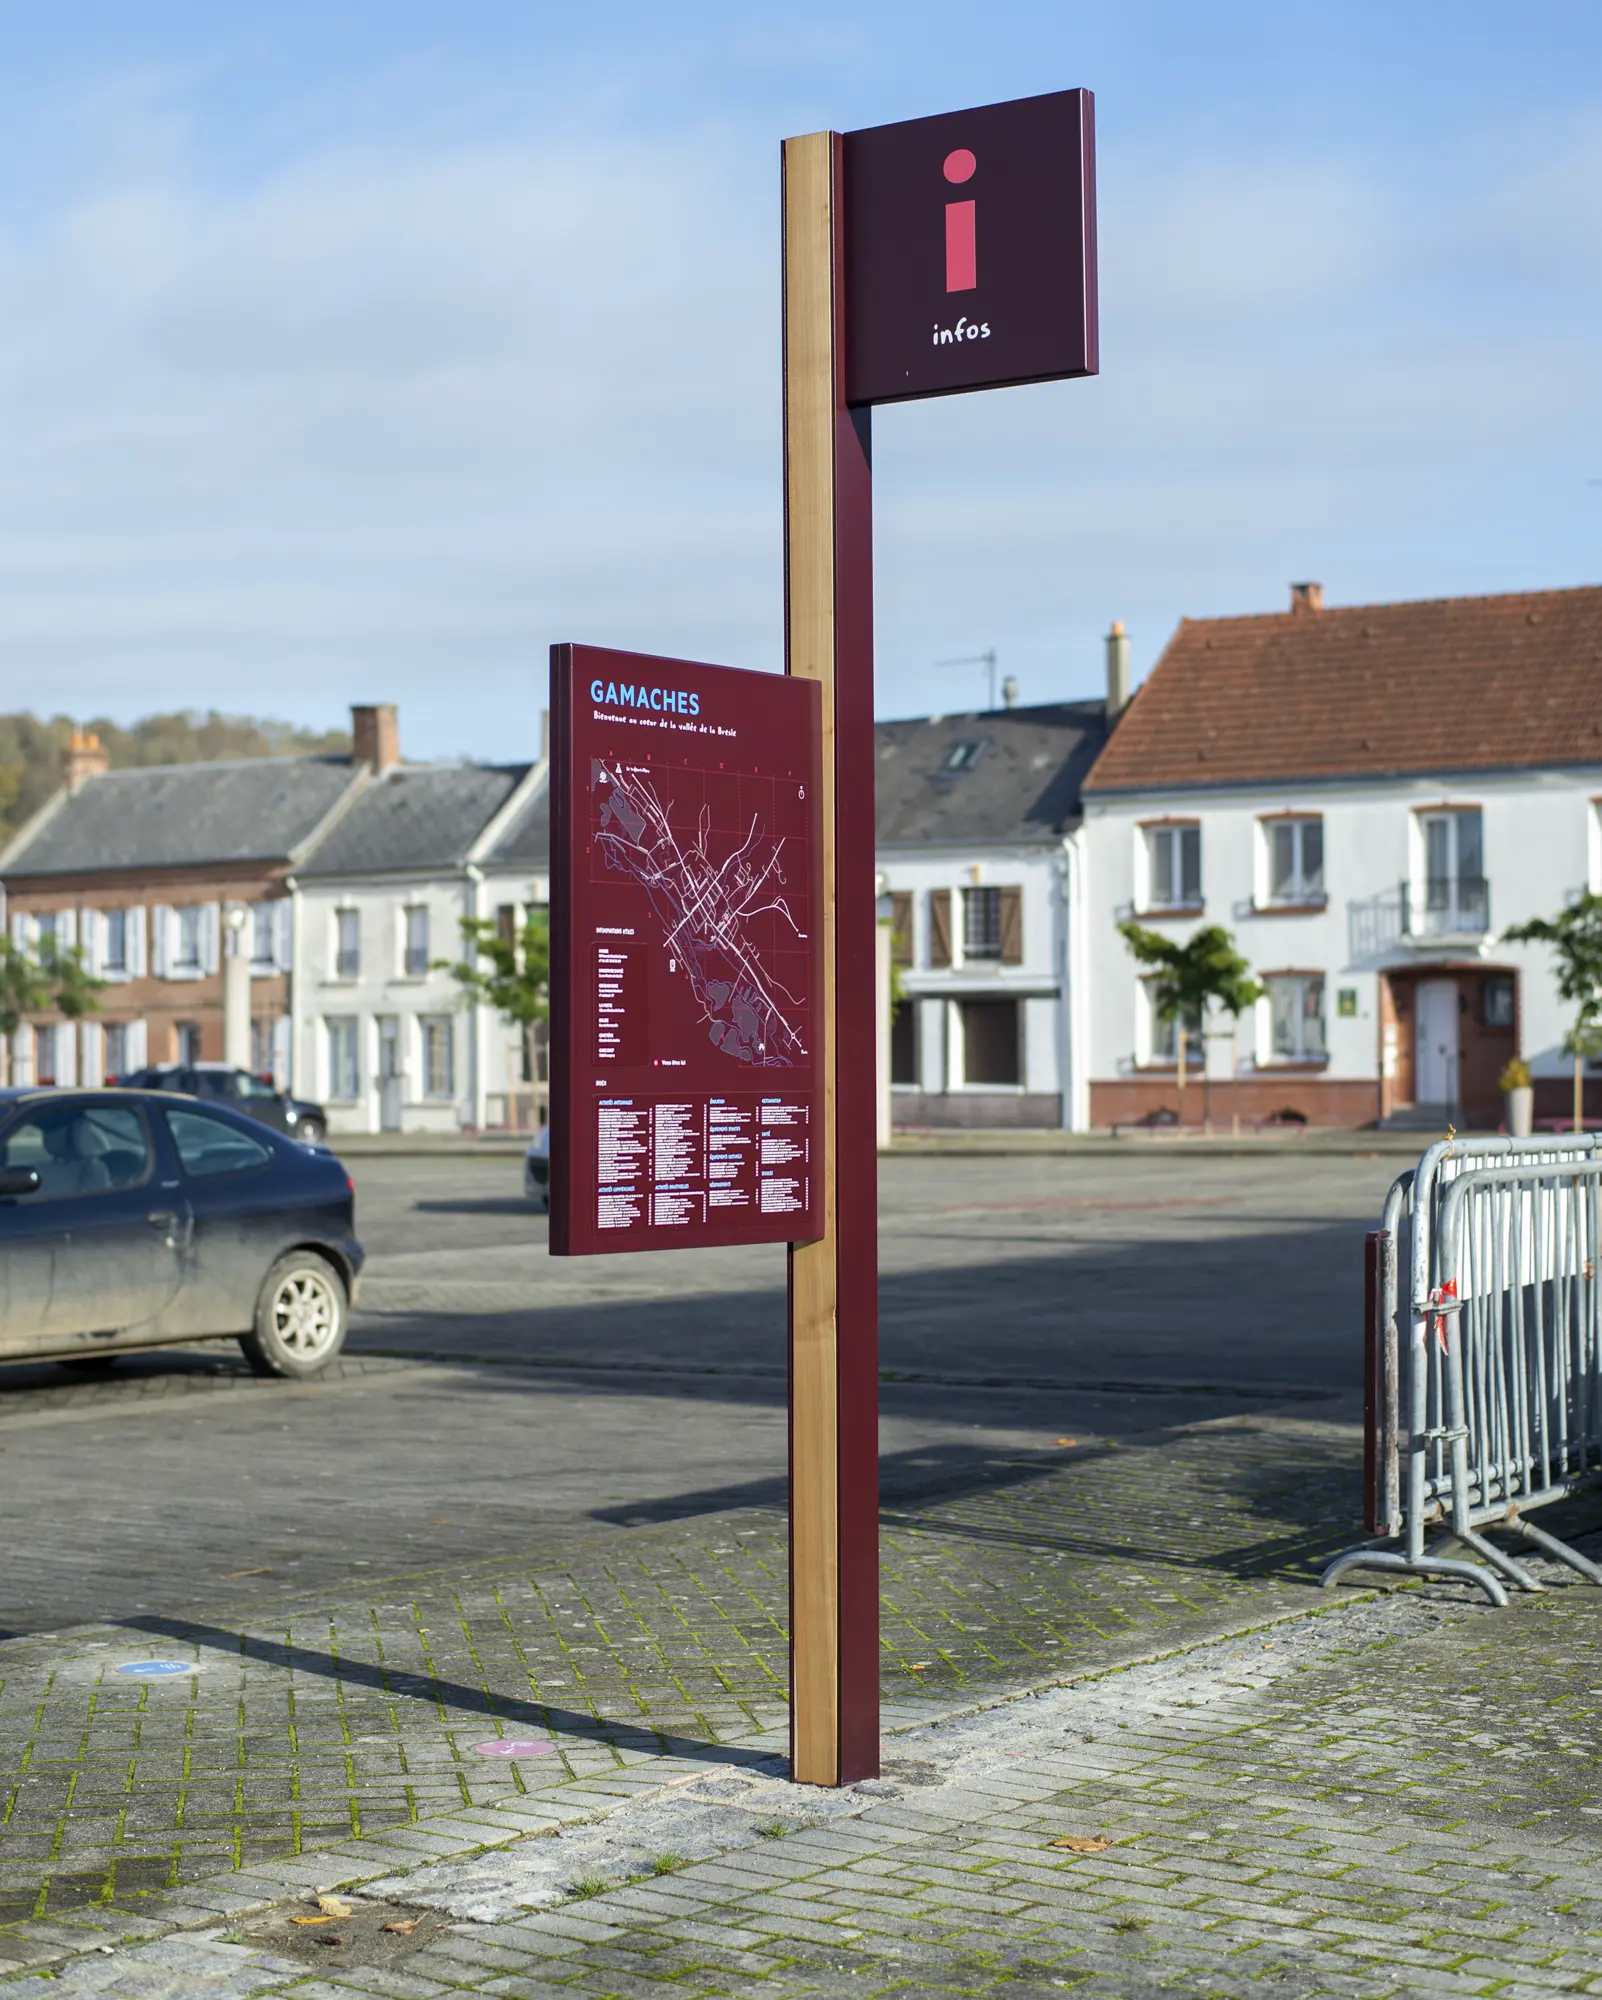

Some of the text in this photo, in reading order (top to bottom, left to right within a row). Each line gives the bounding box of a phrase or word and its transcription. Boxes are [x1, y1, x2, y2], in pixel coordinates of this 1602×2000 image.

[932, 316, 991, 346] infos
[590, 679, 700, 716] GAMACHES
[593, 709, 627, 723] Bienvenue
[659, 718, 669, 729] de
[670, 720, 677, 729] la
[678, 721, 698, 732] vallée
[699, 723, 708, 734] de
[709, 725, 716, 735] la
[717, 726, 737, 738] Bresle
